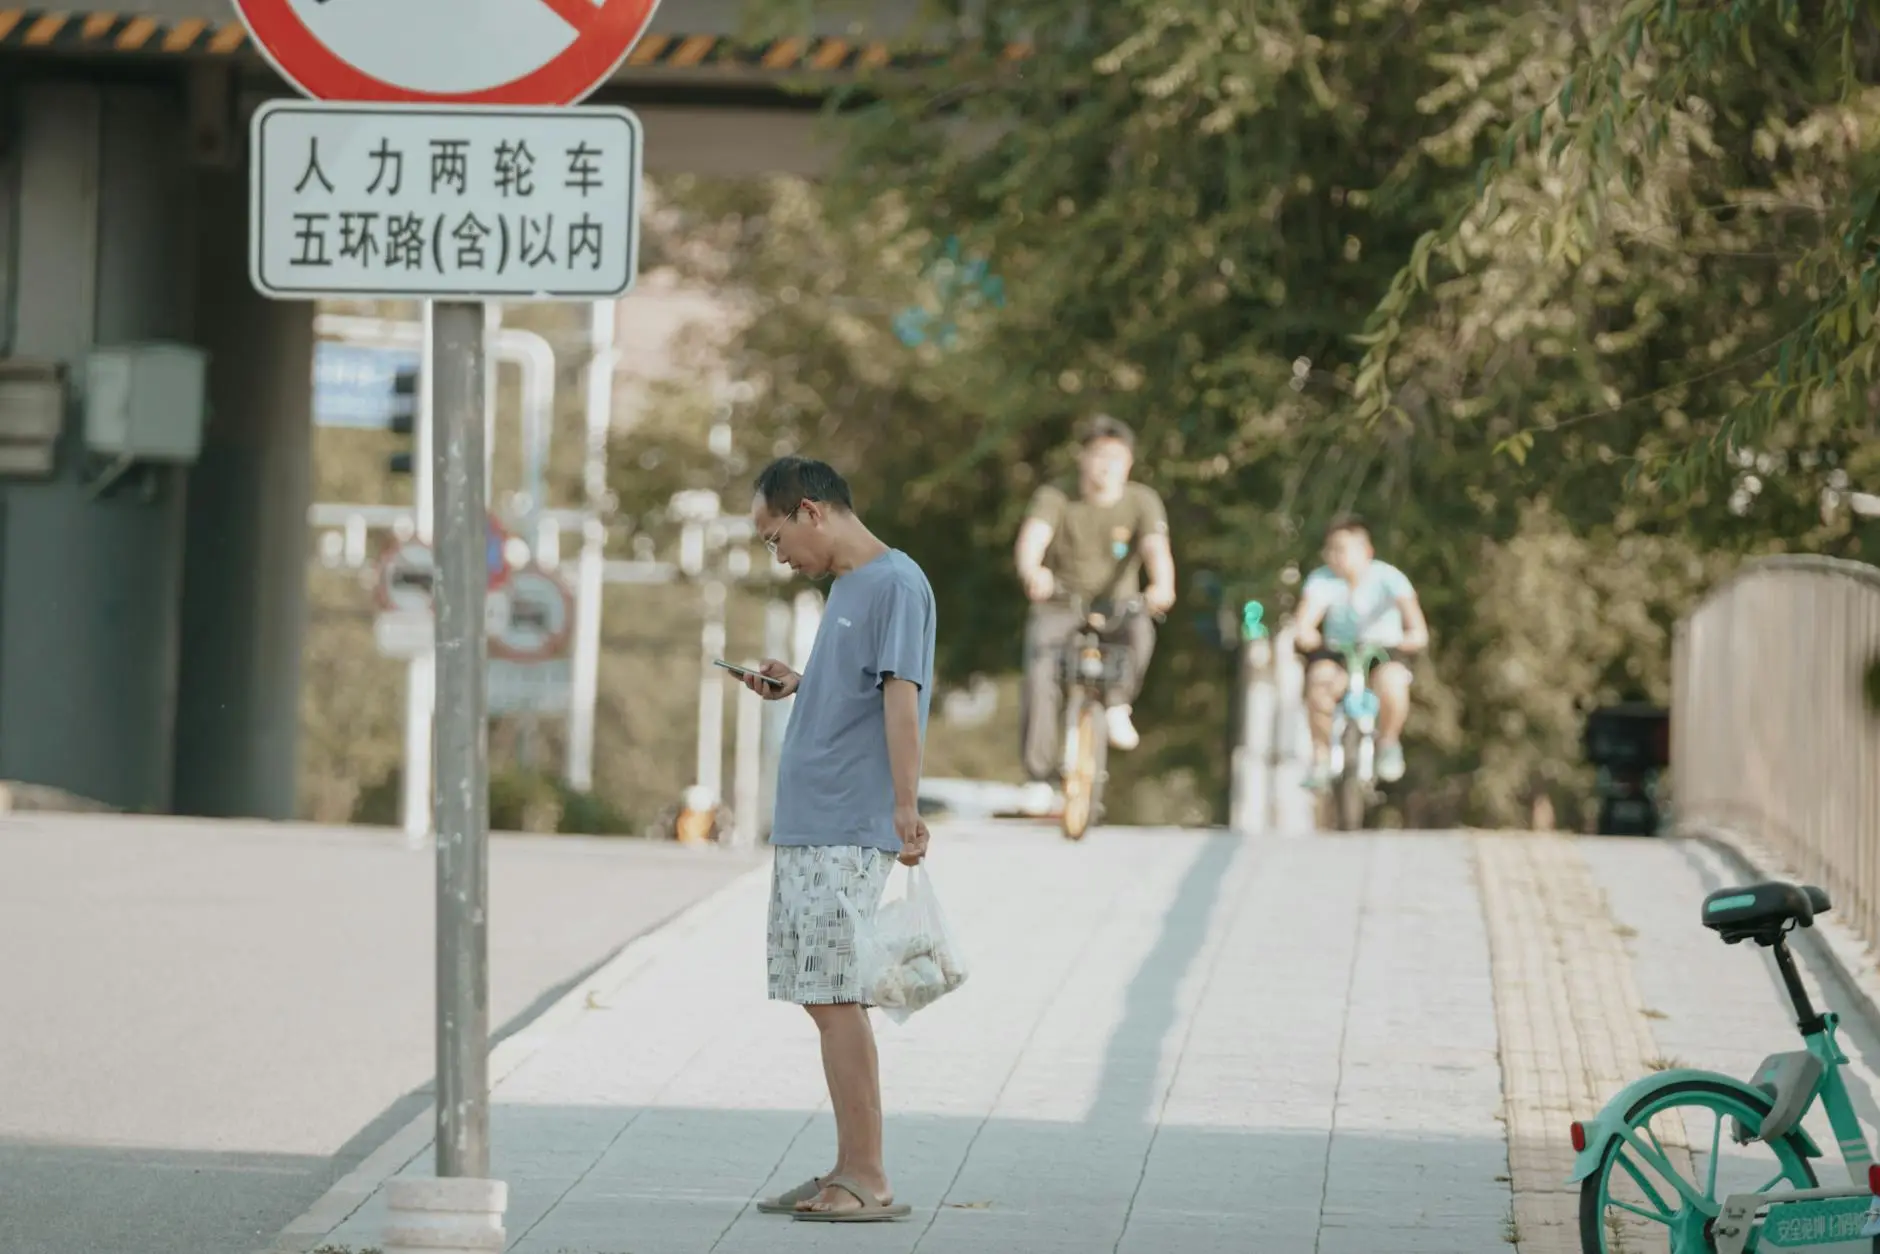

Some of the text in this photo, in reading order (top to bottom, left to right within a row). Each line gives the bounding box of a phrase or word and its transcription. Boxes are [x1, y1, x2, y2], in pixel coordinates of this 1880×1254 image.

[294, 136, 604, 197] 人力两轮车
[290, 211, 604, 274] 五环路(含)以内
